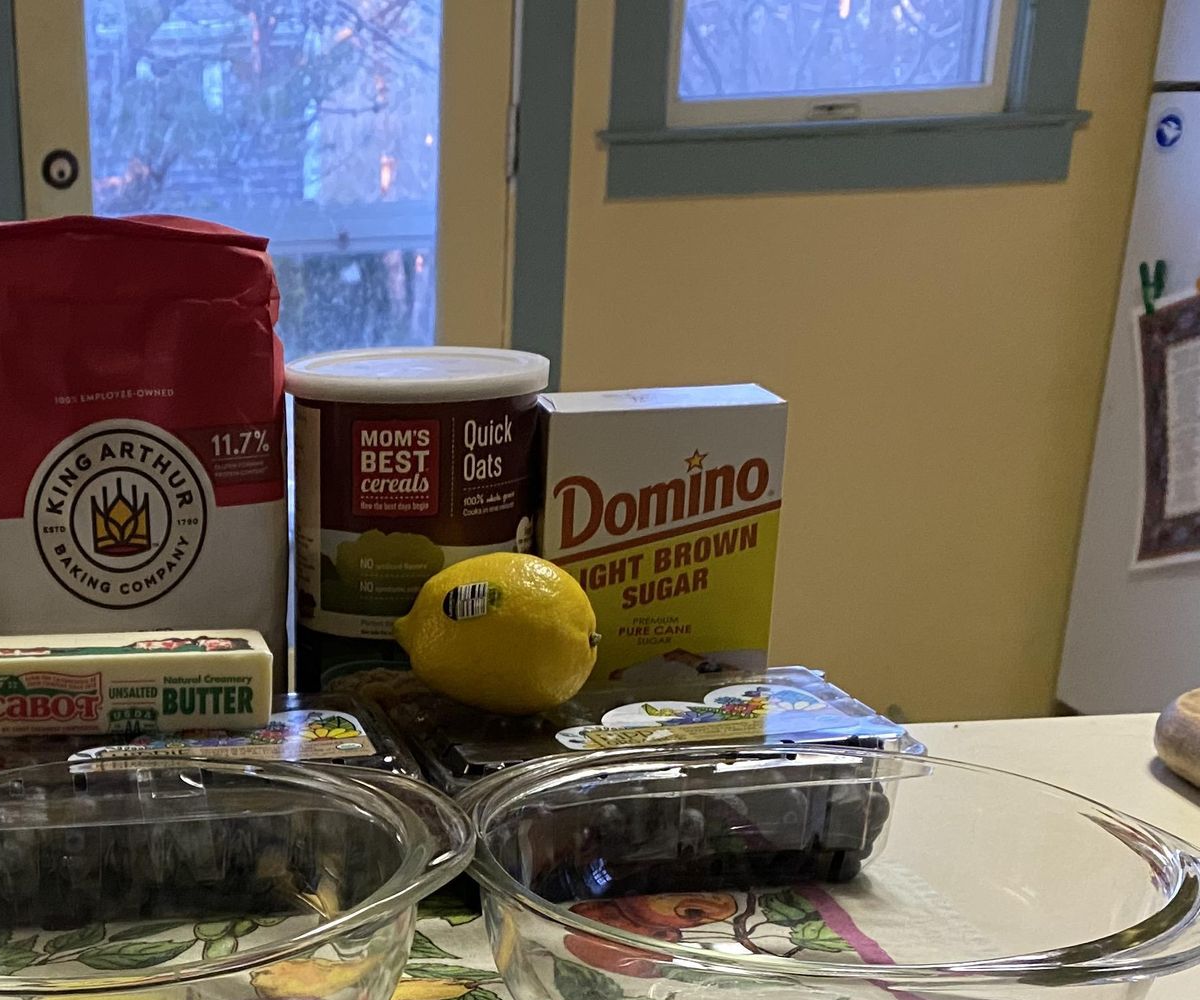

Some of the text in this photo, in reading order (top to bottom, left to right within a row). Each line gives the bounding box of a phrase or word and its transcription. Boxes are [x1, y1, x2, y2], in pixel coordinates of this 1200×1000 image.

[80, 388, 175, 403] EMPLOYEE-OWNED
[361, 429, 430, 447] MOM'S
[464, 414, 513, 451] Quick
[211, 430, 270, 456] 11.7%
[361, 450, 430, 473] BEST
[463, 453, 502, 481] Oats
[46, 442, 194, 515] KING ARTHUR
[360, 473, 430, 493] cereals
[384, 502, 397, 511] best
[412, 501, 430, 512] begin
[463, 493, 484, 506] 100%
[553, 455, 770, 549] Domino
[54, 535, 189, 595] BAKING COMPANY
[360, 558, 374, 569] NO
[579, 523, 758, 591] IGHT BROWN
[360, 581, 374, 593] NO
[622, 567, 709, 610] SUGAR
[618, 625, 692, 636] PURE CANE
[632, 616, 680, 625] PREMIUM
[164, 674, 253, 687] Natural Creamery
[108, 686, 158, 700] UNSALTED
[162, 686, 254, 716] BUTTER
